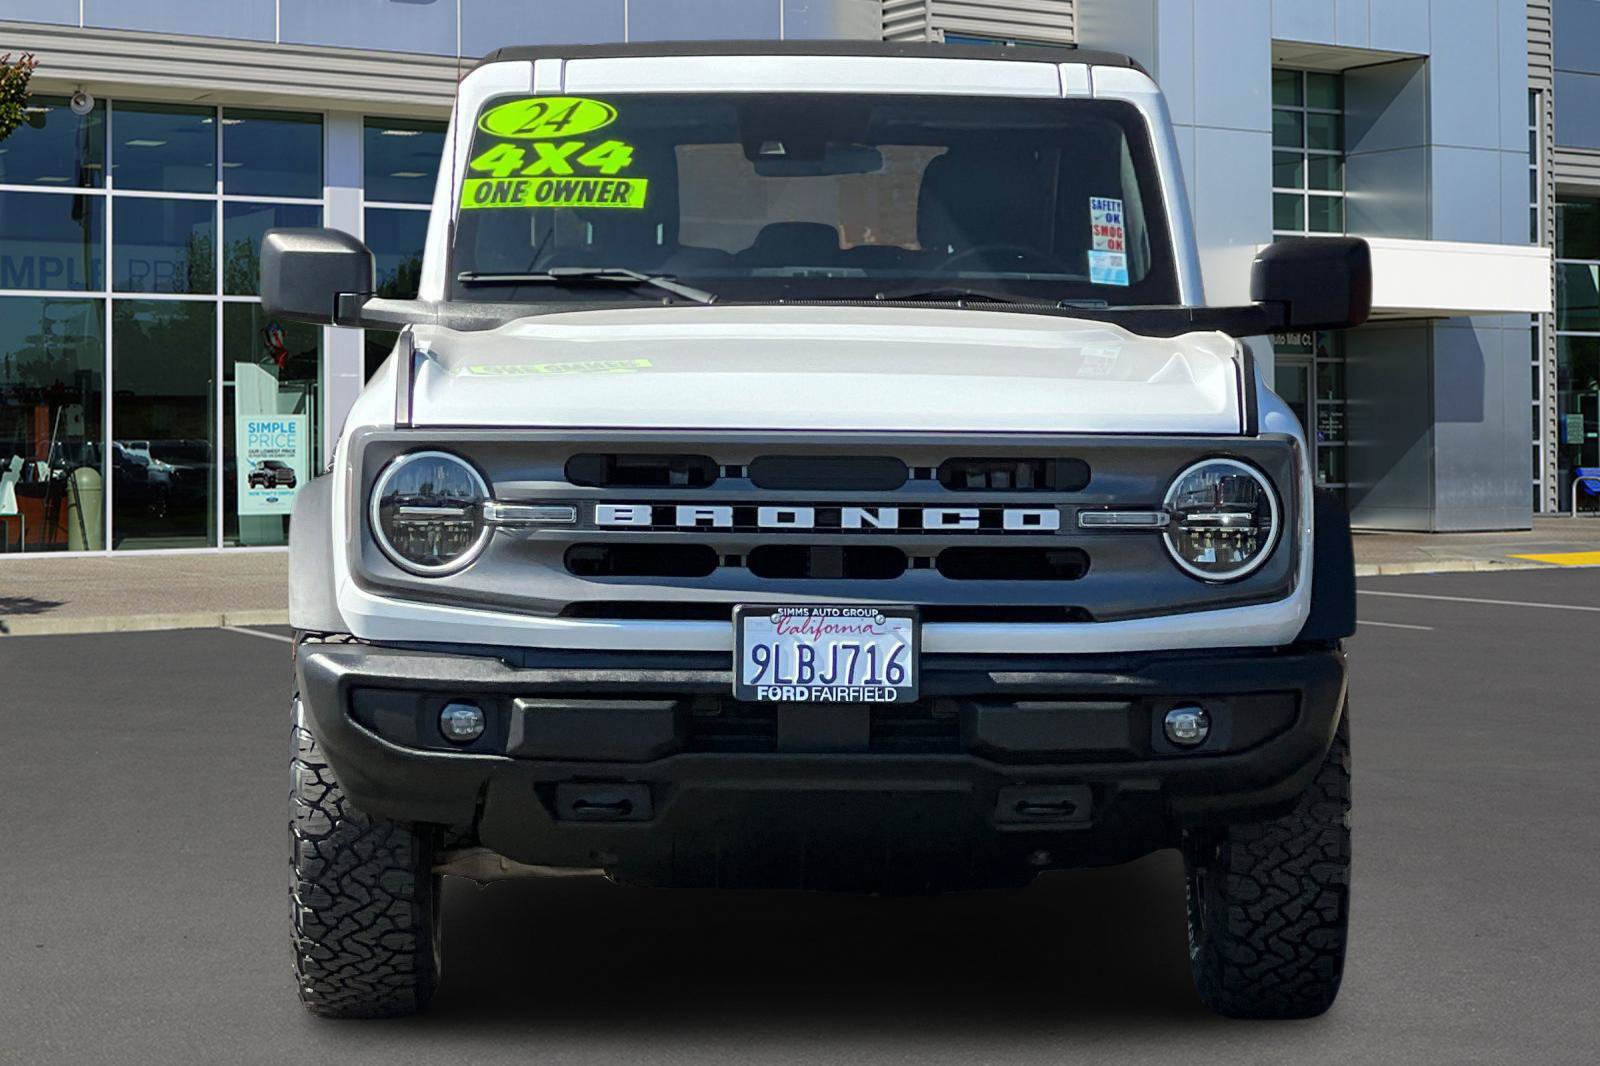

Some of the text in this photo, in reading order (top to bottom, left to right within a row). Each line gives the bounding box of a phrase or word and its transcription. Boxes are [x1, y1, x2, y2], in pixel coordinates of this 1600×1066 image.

[512, 101, 583, 134] 24
[474, 180, 633, 204] ONE OWNER
[1091, 199, 1121, 212] SAFETY
[1106, 213, 1121, 224] OK
[1093, 225, 1123, 239] SMOG
[1107, 239, 1123, 251] OK
[0, 255, 105, 289] MPLE
[248, 422, 296, 433] SIMPLE
[248, 433, 296, 448] PRICE
[595, 504, 1061, 530] BRONCO
[777, 607, 879, 618] SIMMS AUTO GROUP
[776, 614, 885, 642] California
[750, 643, 906, 685] 9LBJ716
[757, 686, 897, 702] FORD FAIRFIELD
